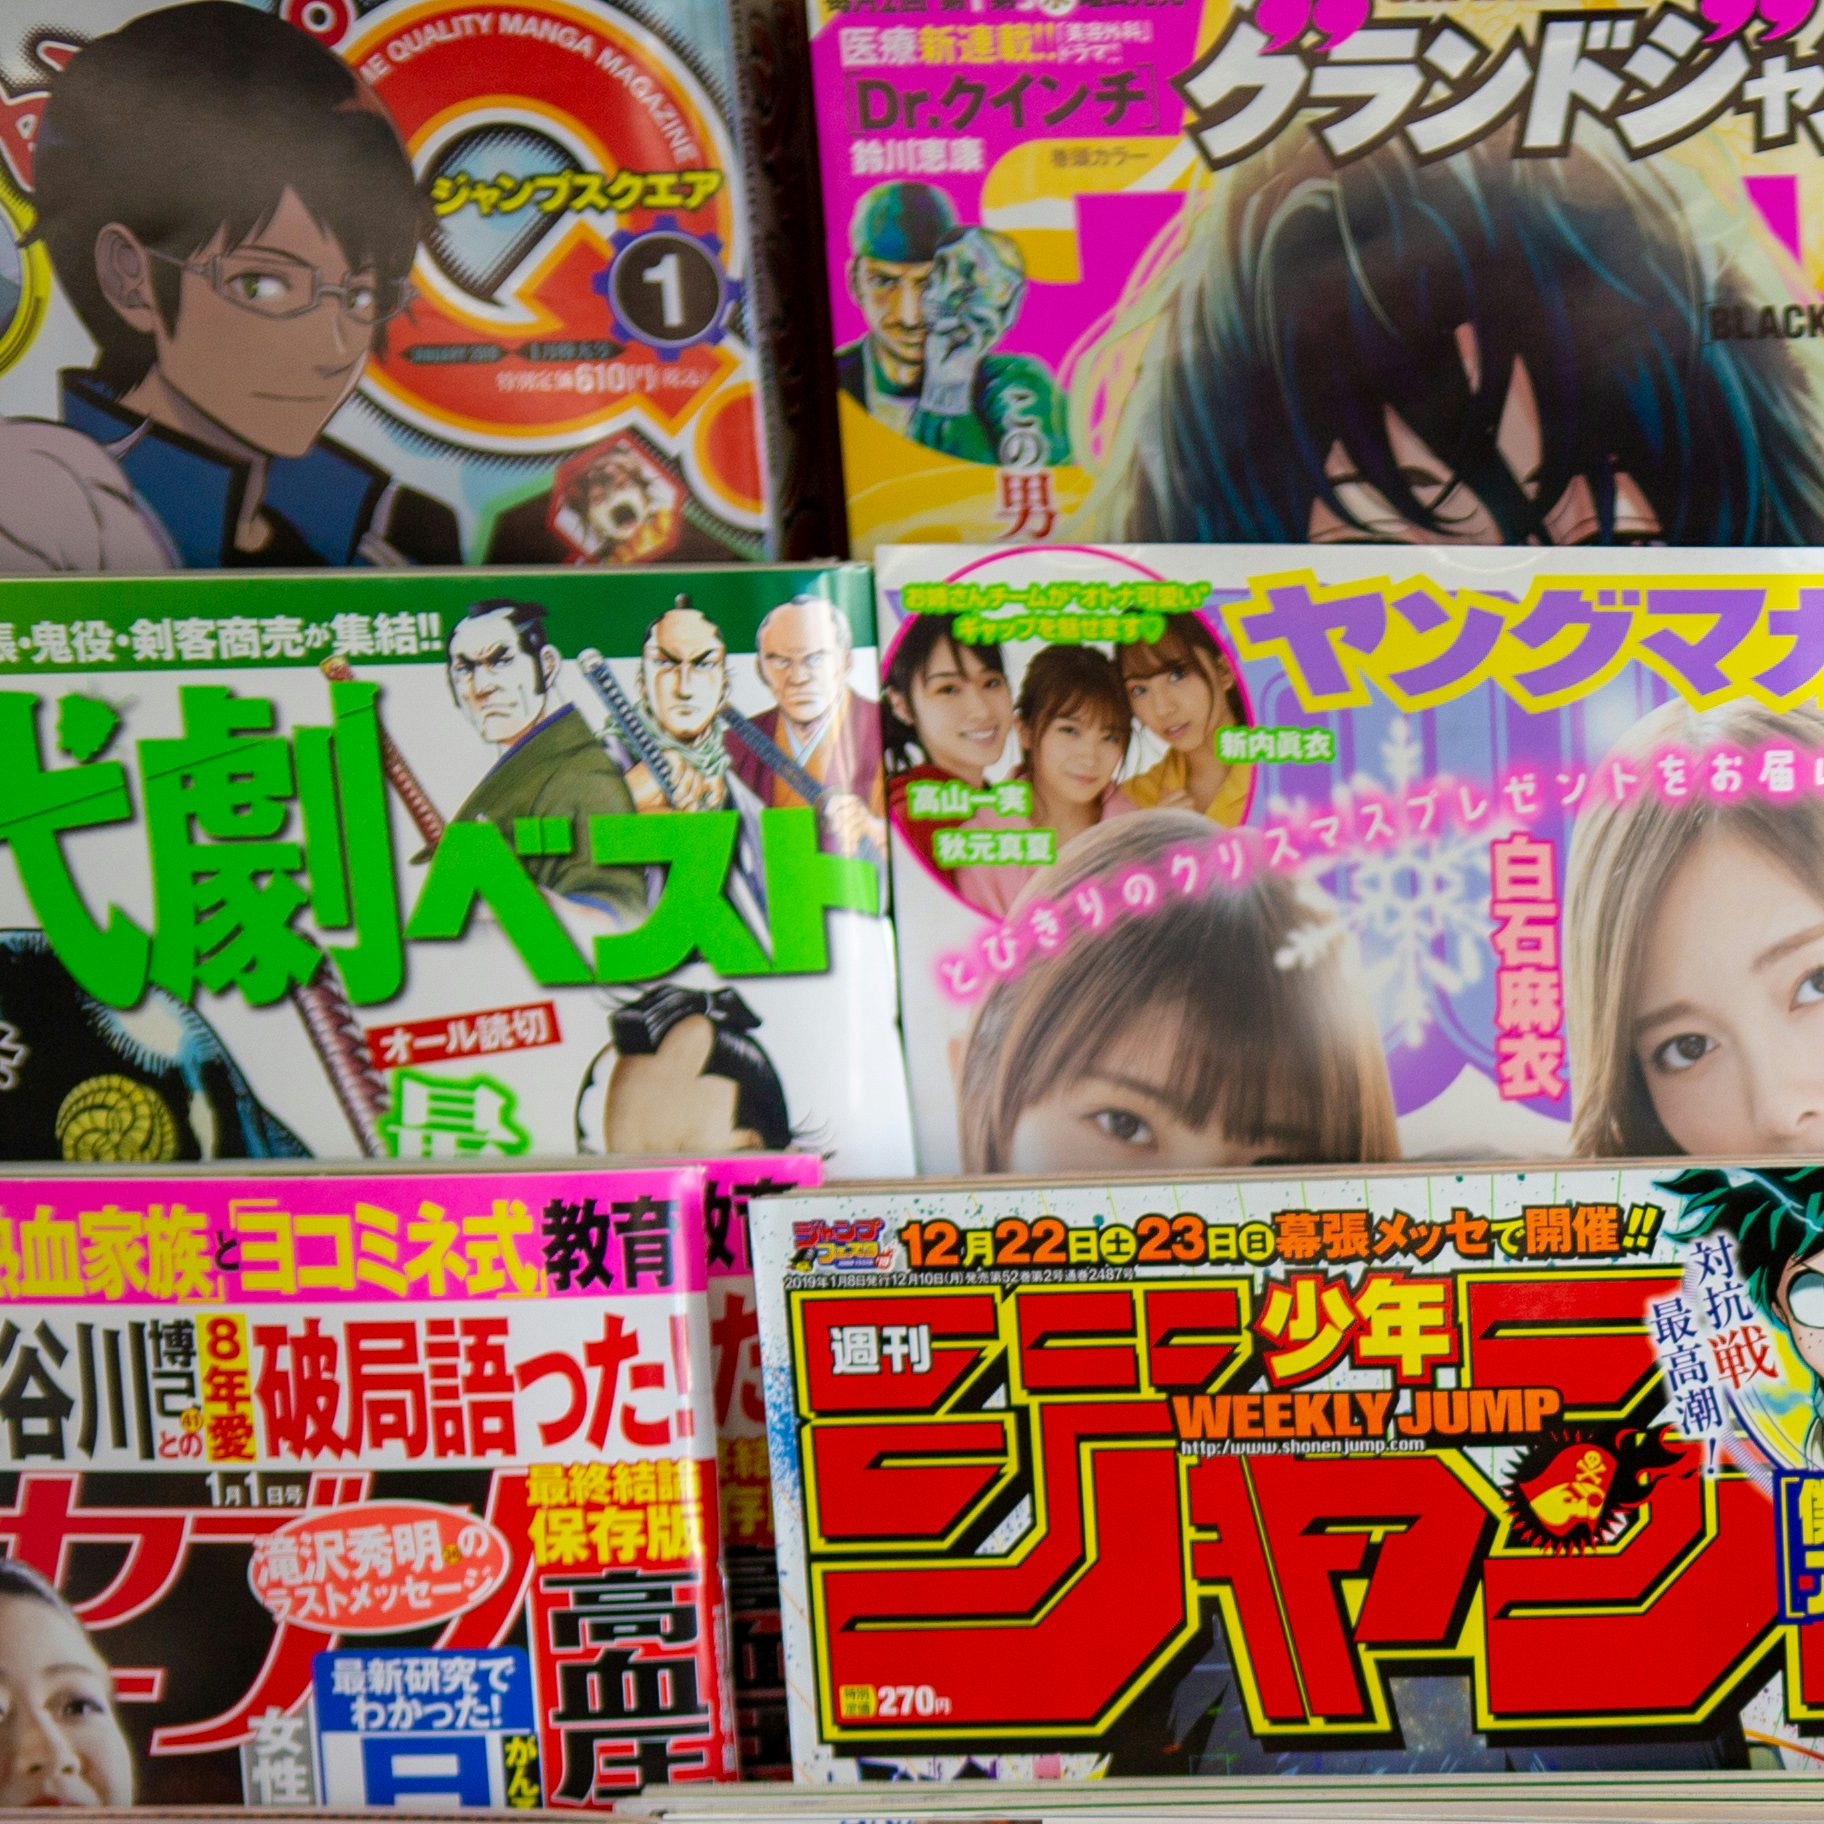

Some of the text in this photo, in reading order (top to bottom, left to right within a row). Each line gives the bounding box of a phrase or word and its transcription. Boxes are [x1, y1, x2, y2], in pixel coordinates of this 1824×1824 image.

[386, 12, 698, 164] QUALITY MANGA MAGAZINE
[430, 168, 725, 217] ジャンプスクエア
[642, 253, 686, 330] 1
[1490, 832, 1567, 1104] 白石麻衣
[380, 1013, 550, 1054] オール読切
[1252, 1270, 1458, 1390] 少年
[1690, 1234, 1779, 1390] 対抗戦
[828, 1324, 933, 1376] 週刊
[1172, 1387, 1562, 1439] WEEKLY JUMP
[205, 1470, 303, 1508] 1月1日号
[530, 1506, 705, 1567] 保存版
[330, 1653, 516, 1697] 最新研究で
